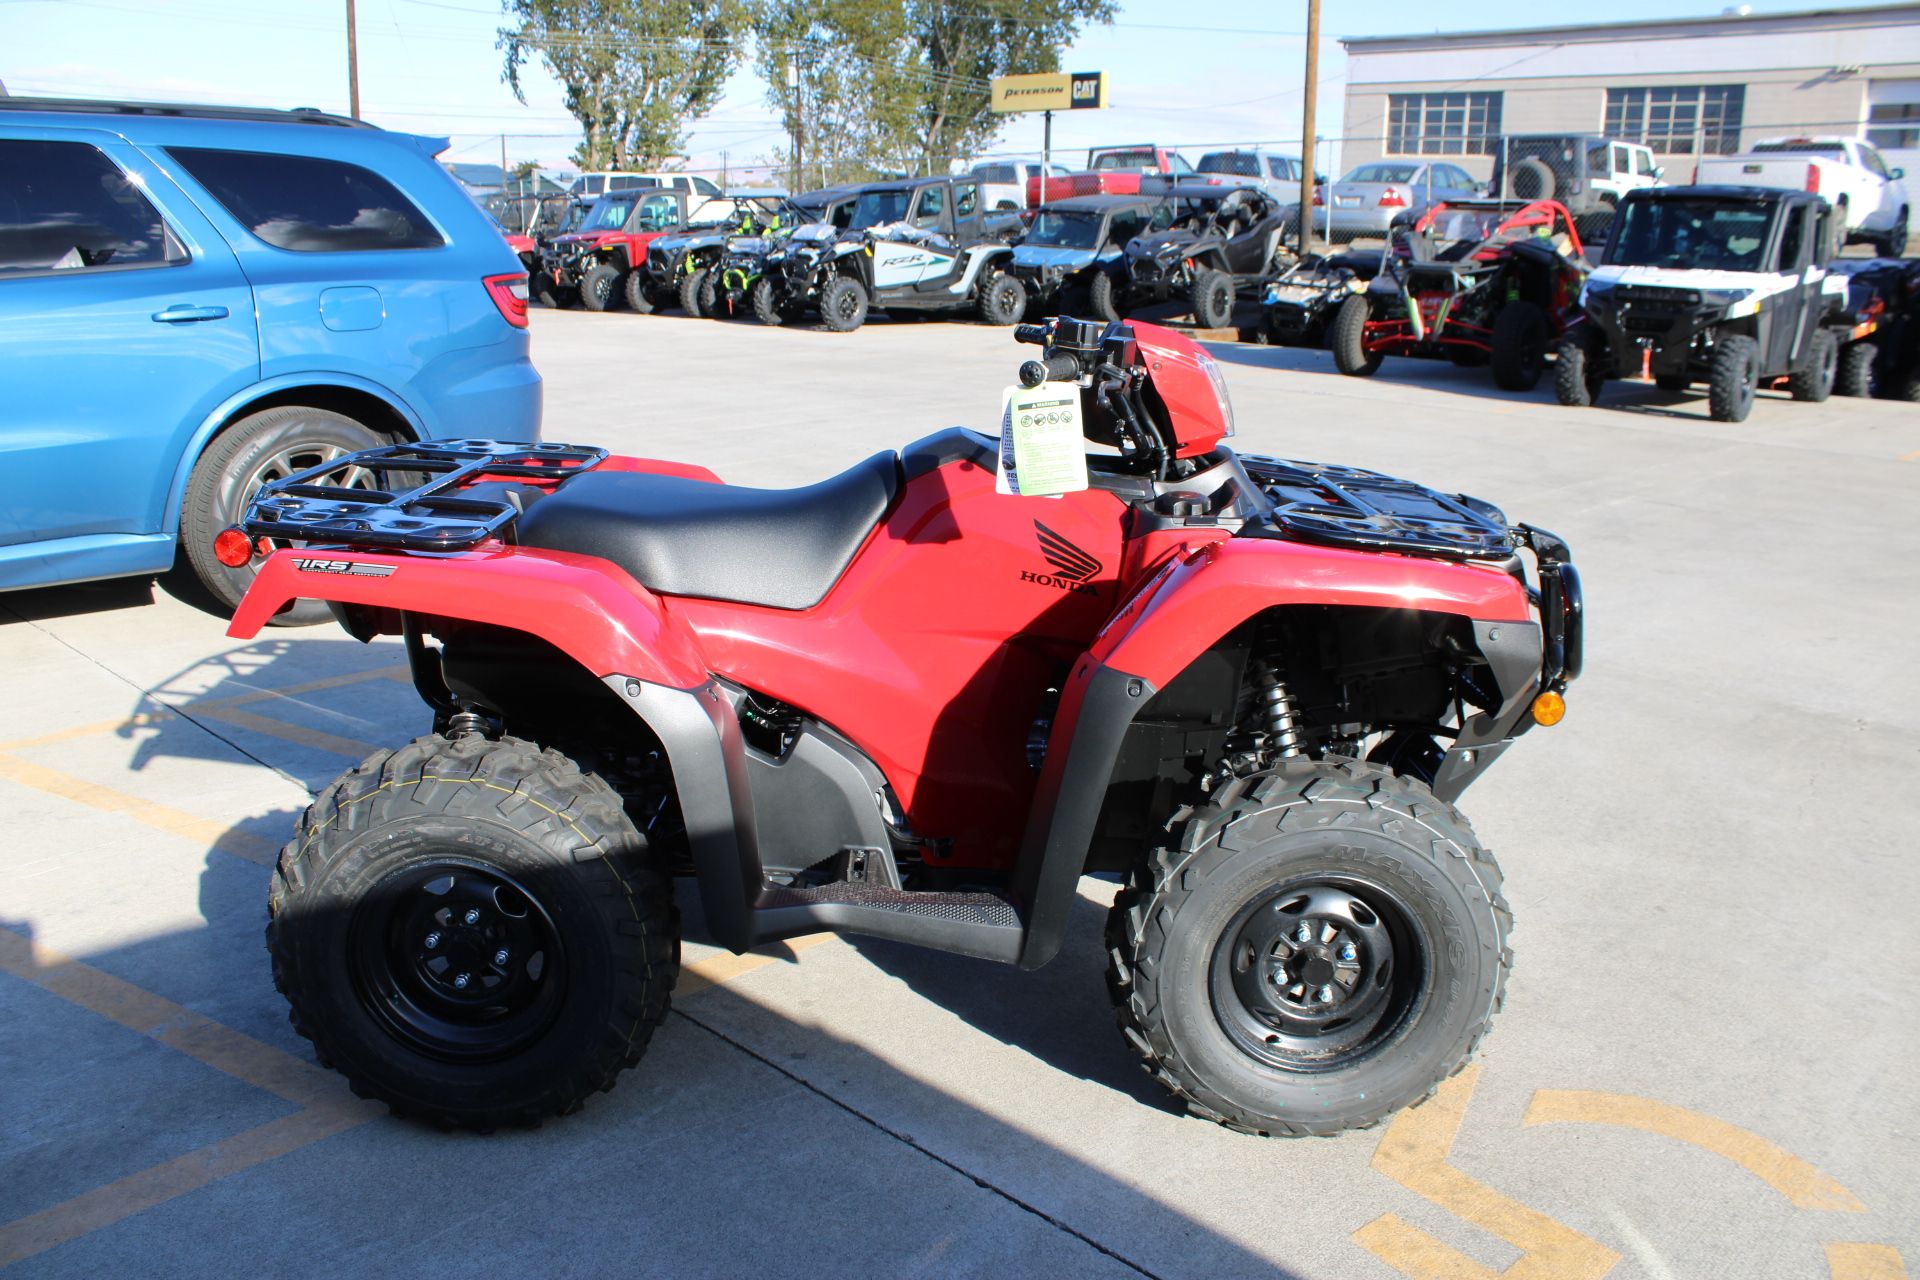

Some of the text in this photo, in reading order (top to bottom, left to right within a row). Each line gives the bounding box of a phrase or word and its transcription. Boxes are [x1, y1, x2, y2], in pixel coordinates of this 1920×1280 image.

[1004, 80, 1098, 99] PETERSON CAT
[302, 559, 350, 571] IRS
[1020, 571, 1099, 596] HONDA
[1326, 843, 1467, 969] MAXXIS
